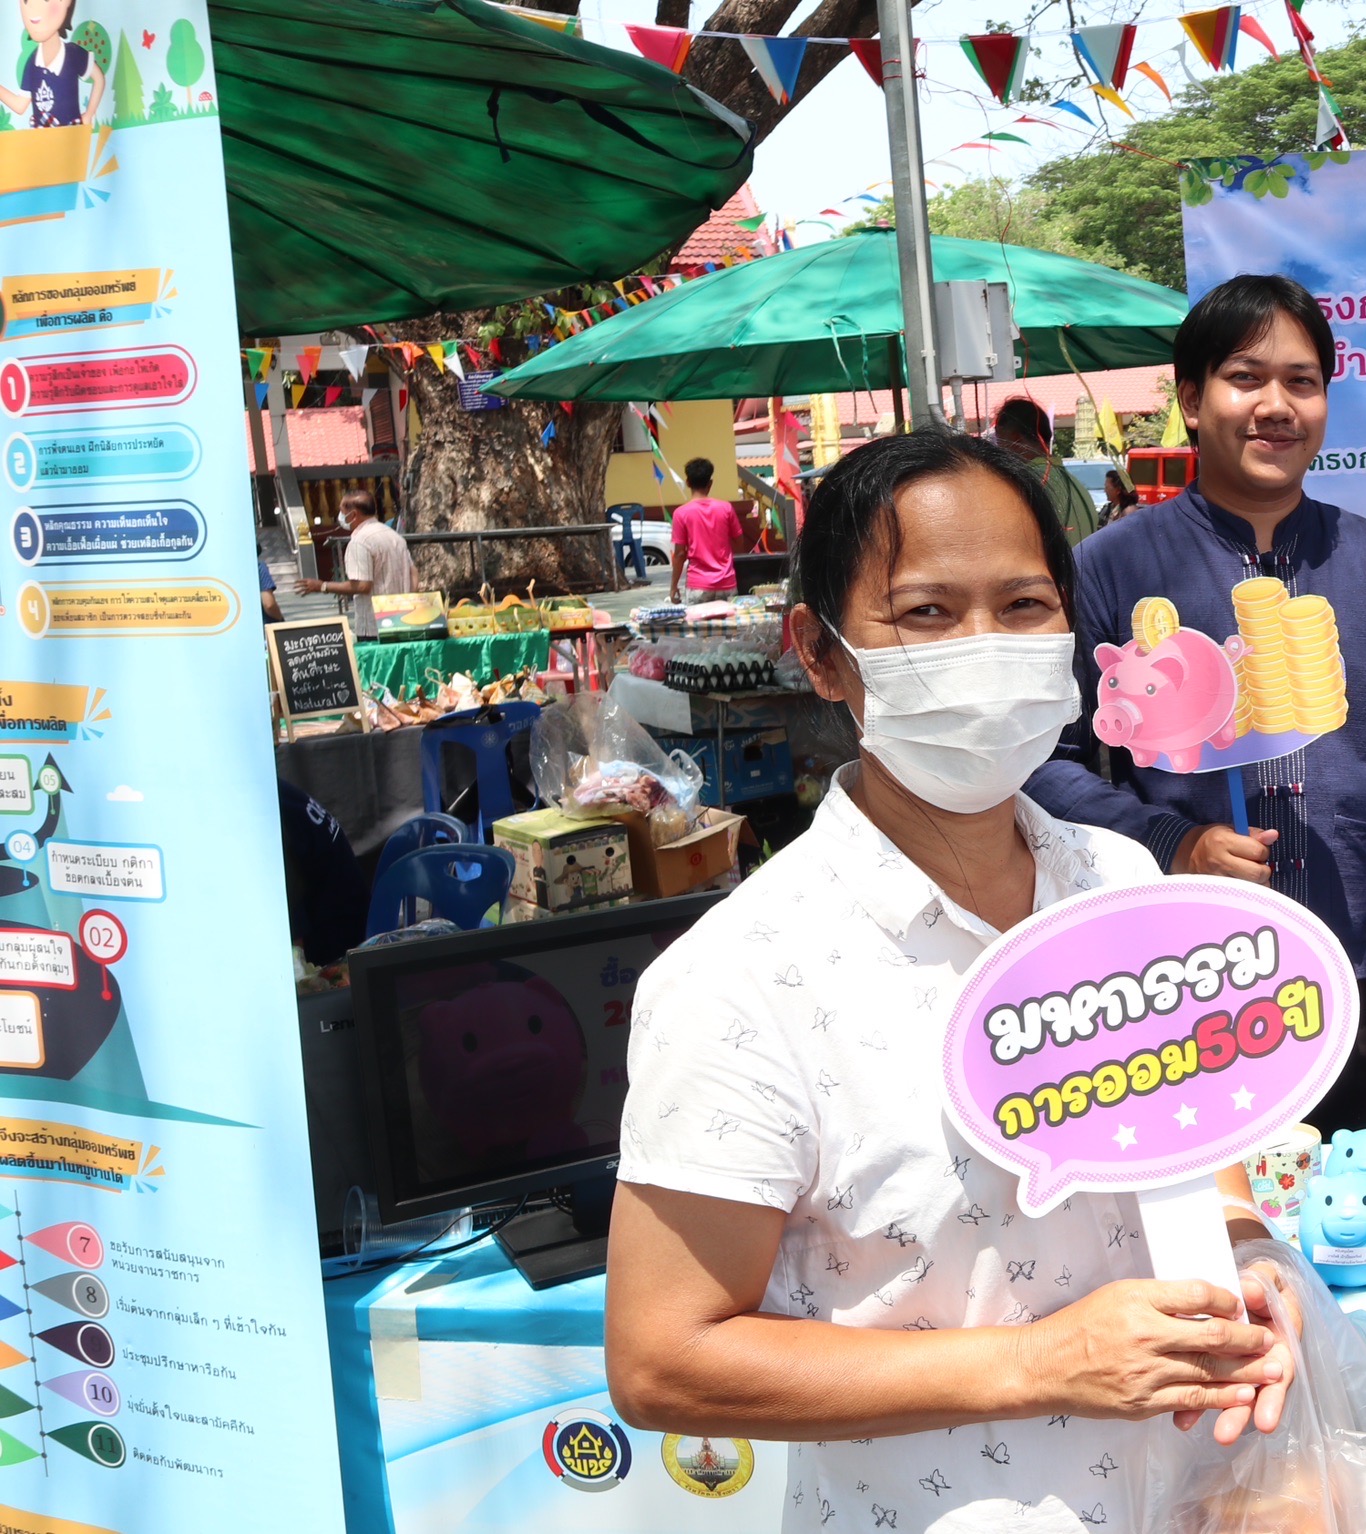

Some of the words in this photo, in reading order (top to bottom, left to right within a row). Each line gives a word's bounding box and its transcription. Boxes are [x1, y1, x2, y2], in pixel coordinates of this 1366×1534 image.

[7, 376, 17, 401] 1
[13, 451, 26, 475] 2
[19, 526, 32, 548] 3
[28, 600, 40, 621] 4
[294, 692, 337, 710] Natural
[43, 774, 56, 786] 05
[13, 840, 31, 853] 04
[89, 926, 115, 948] 02
[986, 927, 1279, 1062] มหกรรม
[78, 1236, 91, 1253] 7
[85, 1286, 98, 1303] 8
[89, 1383, 113, 1404] 10
[95, 1433, 118, 1454] 11
